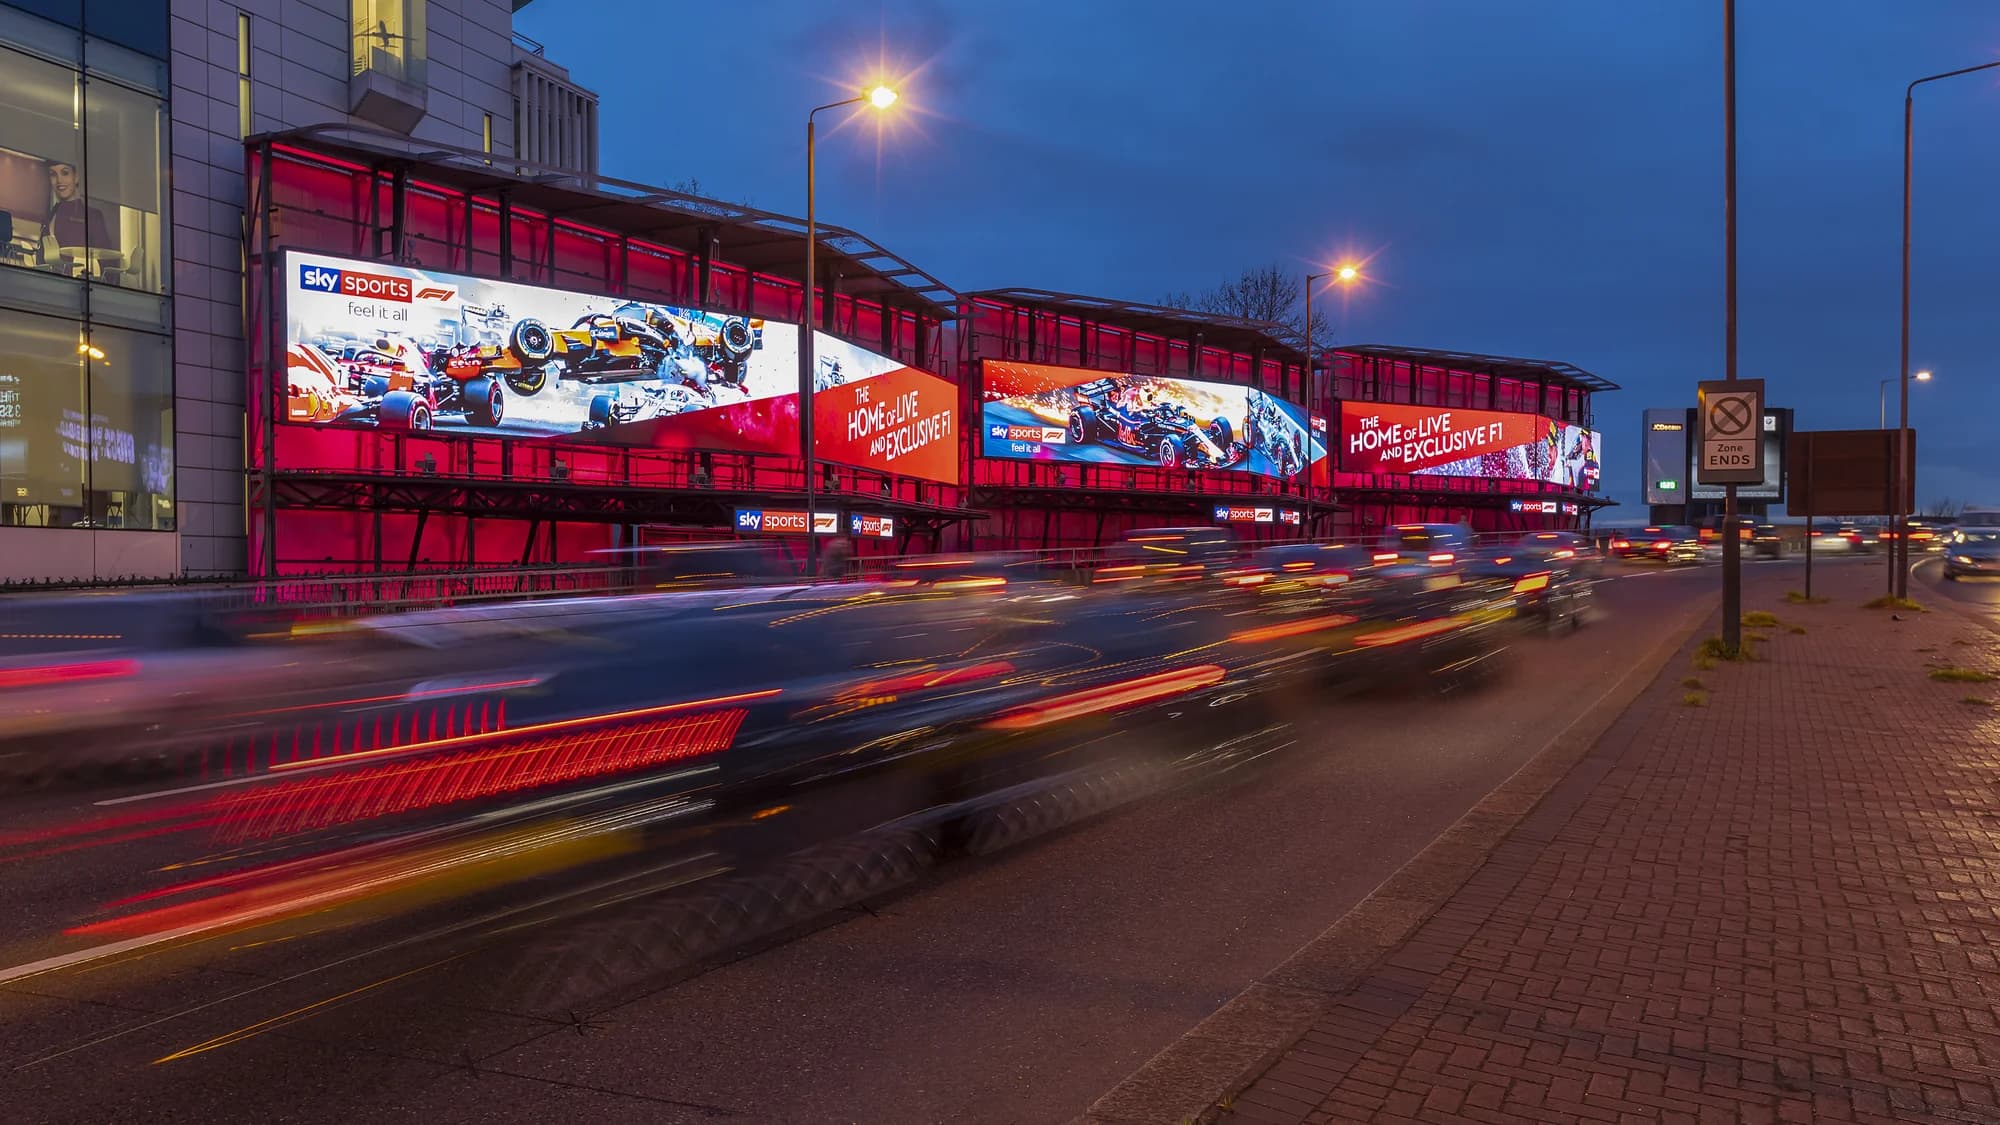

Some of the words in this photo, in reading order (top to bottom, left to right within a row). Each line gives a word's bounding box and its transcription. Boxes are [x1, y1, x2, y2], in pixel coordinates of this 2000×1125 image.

[304, 268, 338, 291] sky
[345, 275, 408, 297] sports
[349, 302, 375, 318] feel
[379, 306, 388, 319] it
[393, 308, 408, 321] all
[855, 385, 869, 405] THE
[848, 401, 885, 441] HOME
[886, 409, 896, 427] OF
[897, 390, 918, 423] LIVE
[1360, 416, 1379, 430] THE
[870, 436, 885, 456] AND
[887, 414, 940, 461] EXCLUSIVE
[942, 410, 950, 437] F1
[991, 426, 1008, 439] sky
[1010, 428, 1042, 439] sports
[1351, 424, 1402, 453] HOME
[1404, 428, 1417, 441] OF
[1419, 413, 1451, 437] LIVE
[1011, 443, 1025, 452] feel
[1026, 443, 1032, 453] it
[1033, 444, 1041, 453] all
[1380, 447, 1402, 461] AND
[1404, 426, 1486, 463] EXCLUSIVE
[1490, 422, 1503, 442] F1
[1717, 444, 1743, 452] Zone
[1711, 455, 1750, 465] ENDS
[1216, 508, 1229, 519] sky
[1230, 510, 1254, 519] sports
[1523, 503, 1542, 511] sports
[739, 512, 761, 529] sky
[765, 514, 805, 529] sports
[852, 515, 862, 533] sky
[863, 520, 881, 533] sports
